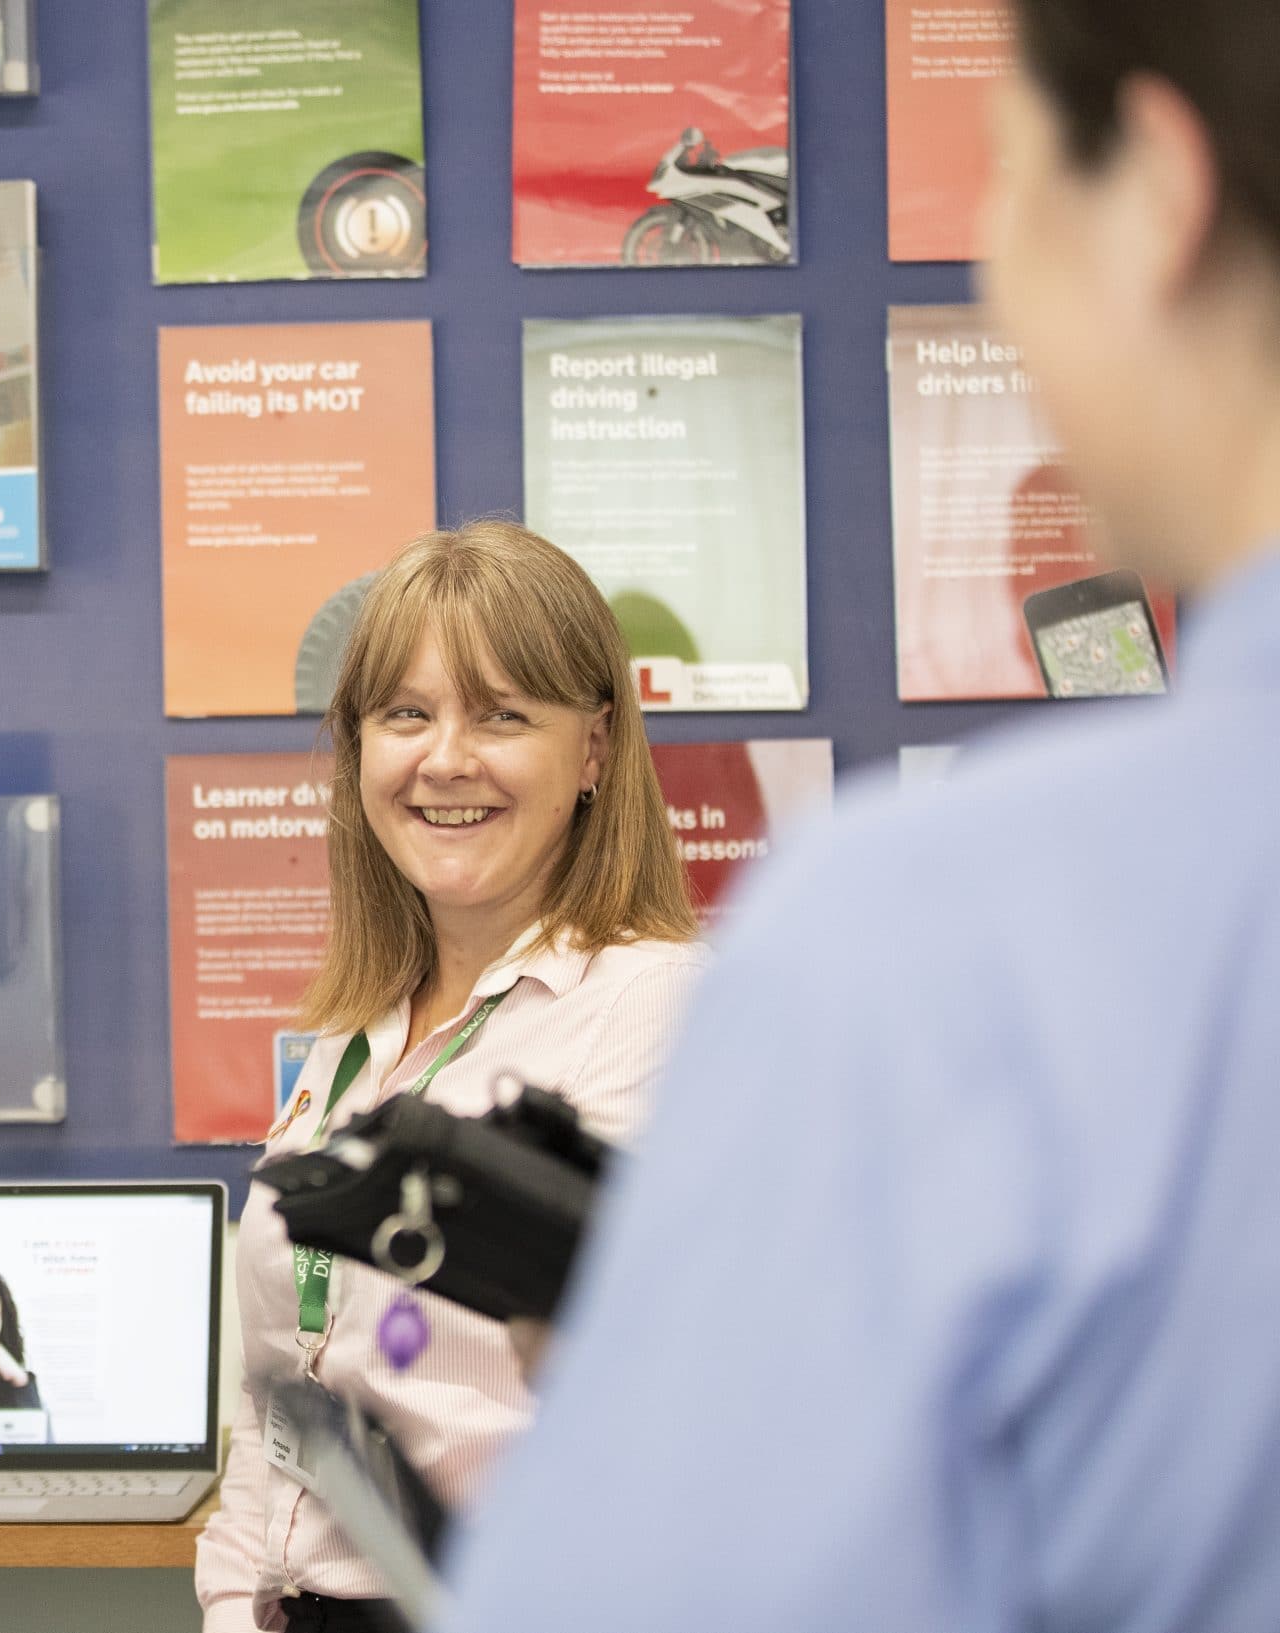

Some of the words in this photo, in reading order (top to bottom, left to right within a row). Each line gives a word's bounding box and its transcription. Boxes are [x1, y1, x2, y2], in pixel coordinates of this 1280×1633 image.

[550, 353, 636, 379] Report
[642, 352, 718, 380] illegal
[917, 340, 976, 368] Help
[184, 359, 256, 383] Avoid
[260, 362, 314, 386] your
[319, 362, 360, 380] car
[917, 371, 1005, 395] drivers
[185, 390, 262, 417] failing
[267, 390, 298, 413] its
[303, 387, 364, 411] MOT
[551, 386, 638, 413] driving
[551, 415, 686, 440] instruction
[639, 668, 672, 702] L
[192, 784, 288, 808] Learner
[194, 819, 226, 839] on
[231, 814, 328, 838] motorw
[668, 804, 696, 829] ks
[701, 803, 725, 829] in
[461, 1004, 494, 1037] DVSA
